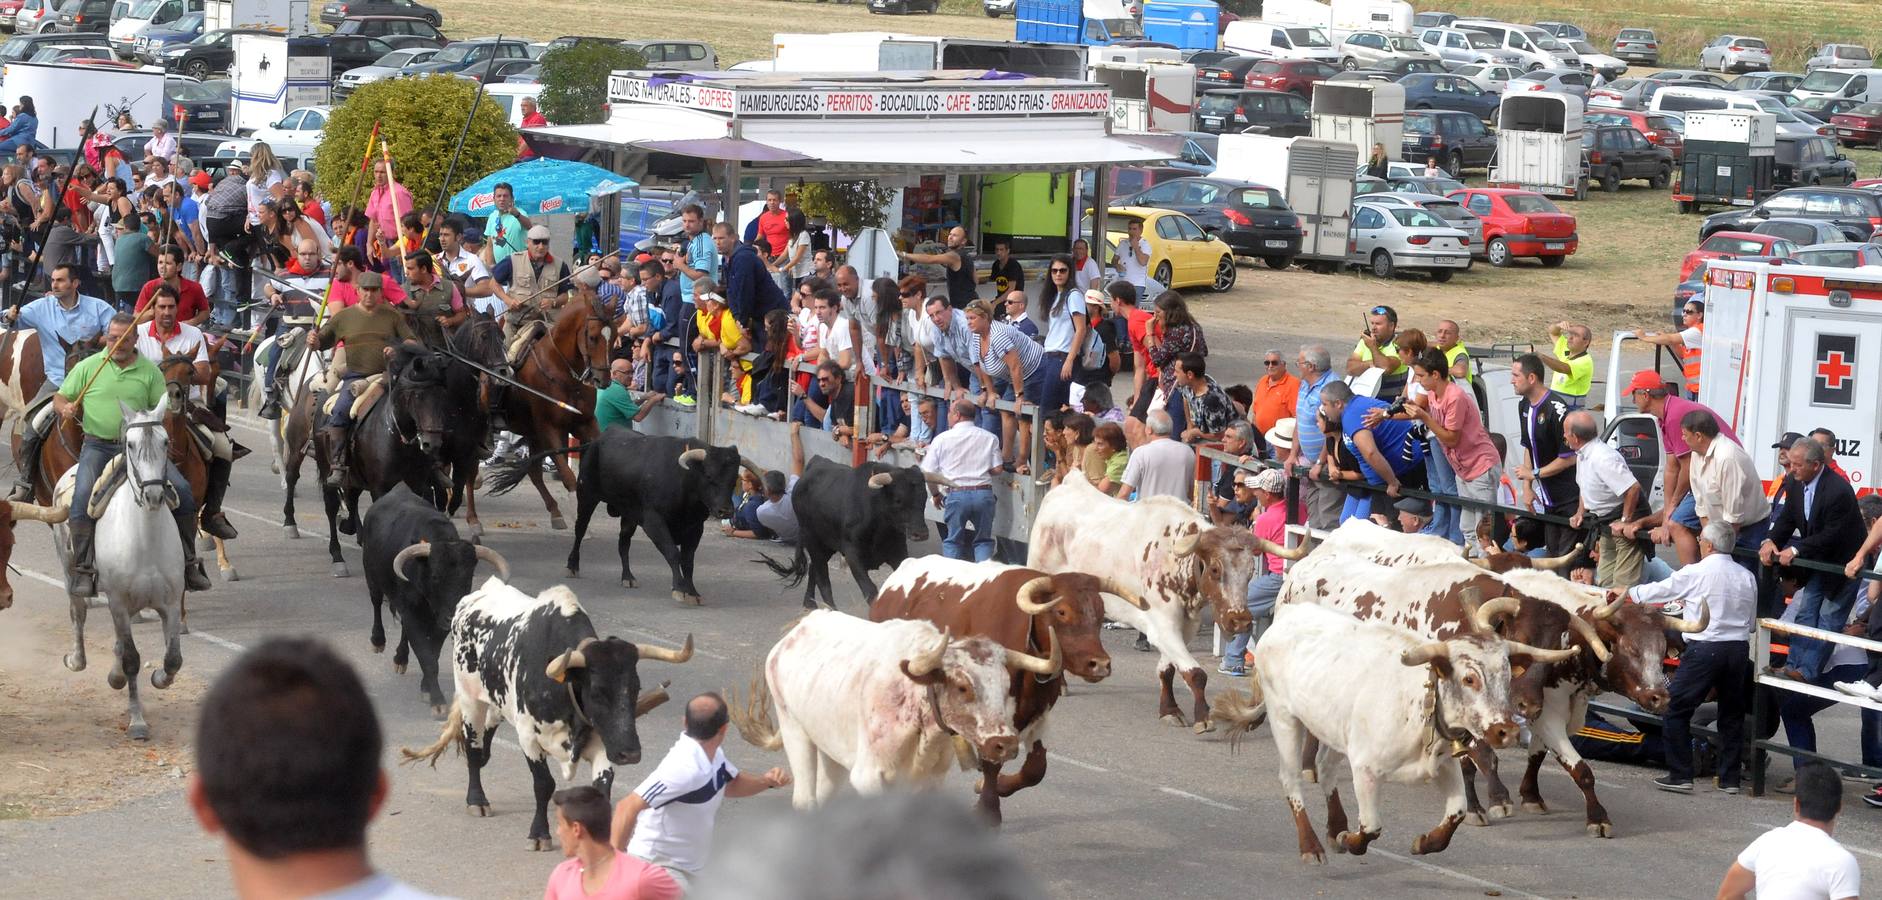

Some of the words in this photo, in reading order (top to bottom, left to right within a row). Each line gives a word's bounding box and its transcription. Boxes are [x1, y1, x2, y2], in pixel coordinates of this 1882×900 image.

[611, 78, 640, 98] ZUMOS
[641, 82, 690, 104] NATURALES
[698, 88, 733, 109] GOFRES
[740, 94, 819, 112] HAMBURGUESAS
[826, 94, 873, 111] PERRITOS
[880, 94, 939, 111] BOCADILLOS
[946, 94, 971, 111] CAFE
[977, 94, 1017, 111] BEBIDAS
[1018, 94, 1045, 111] FRIAS
[1051, 92, 1108, 110] GRANIZADOS
[1835, 438, 1861, 457] uz
